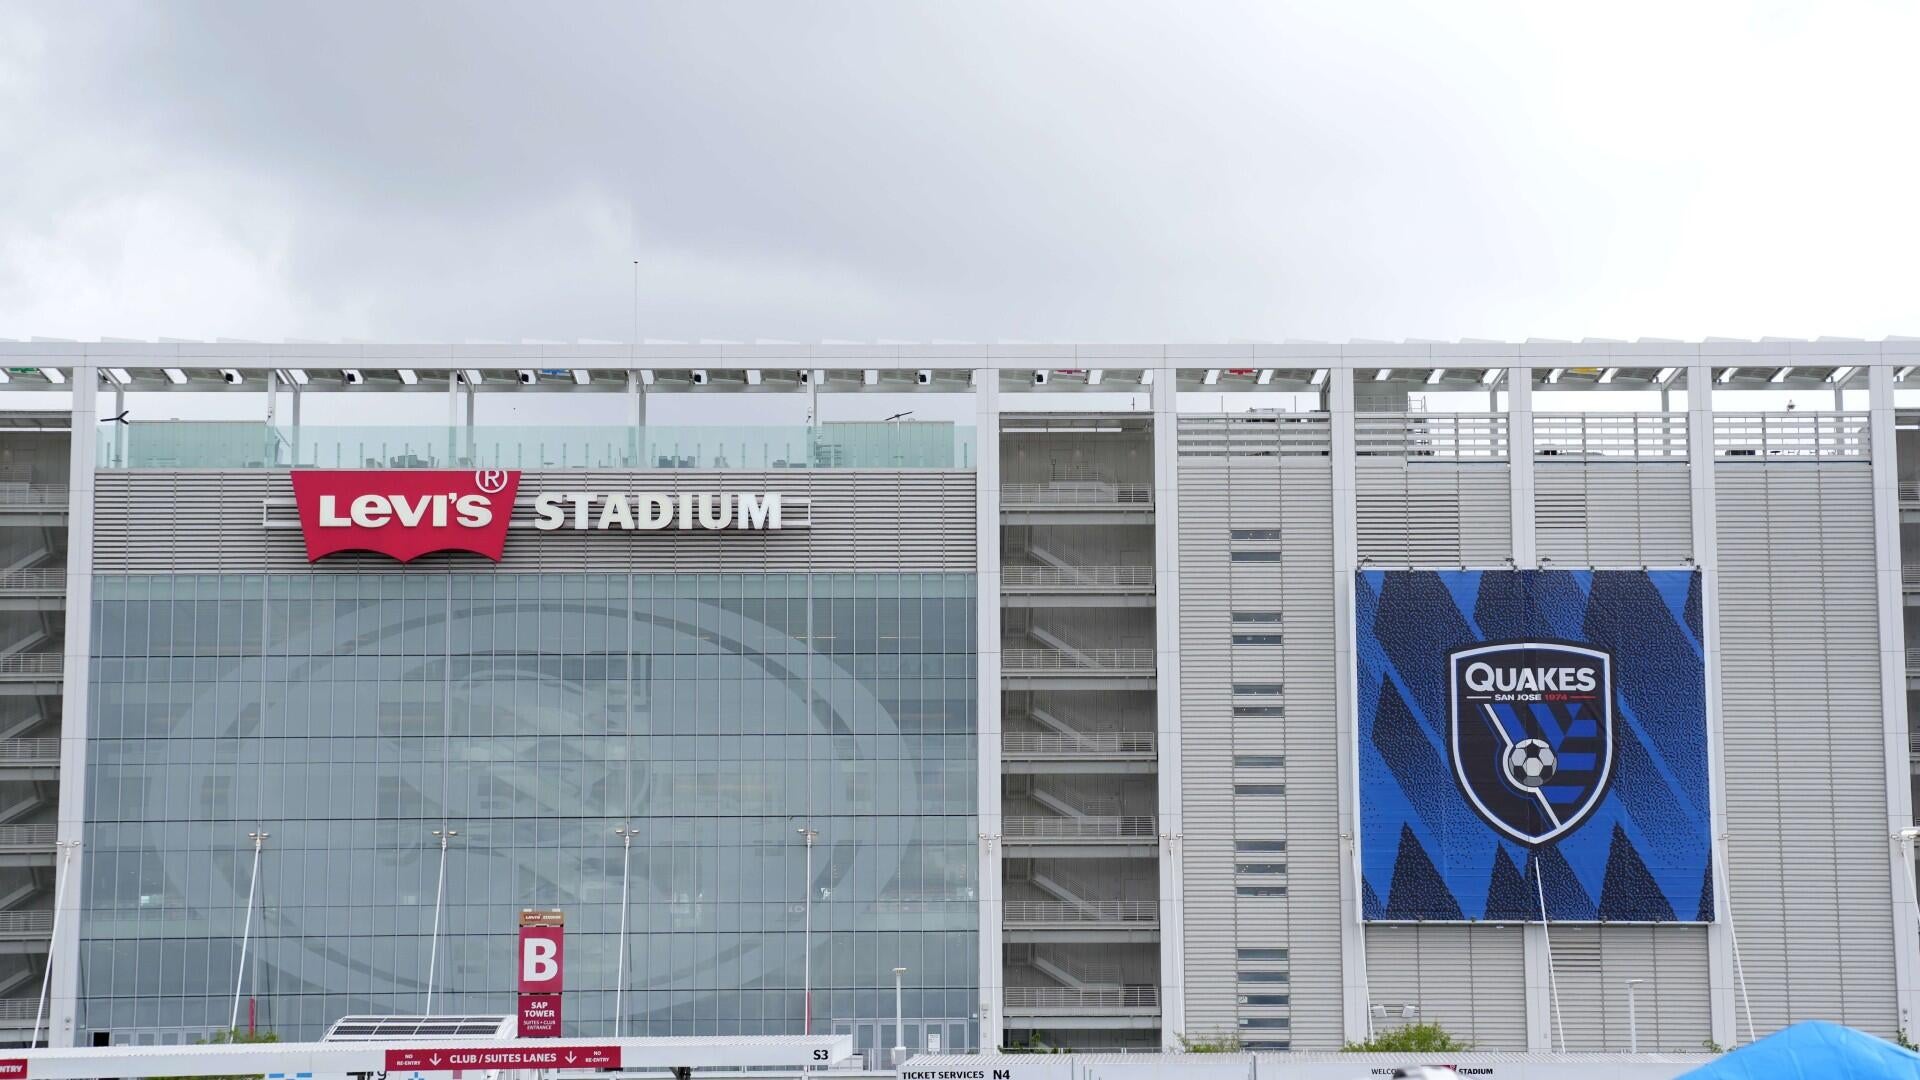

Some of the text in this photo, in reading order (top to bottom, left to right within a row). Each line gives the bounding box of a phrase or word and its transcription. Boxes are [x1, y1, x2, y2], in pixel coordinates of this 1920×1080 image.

[534, 492, 782, 530] STADIUM
[1465, 662, 1597, 692] QUAKES
[524, 938, 558, 981] B
[531, 1001, 548, 1009] SAP
[450, 1053, 557, 1064] CLUB / SUITES LANES
[813, 1049, 829, 1060] S3
[903, 1071, 984, 1080] TICKET SERVICES
[993, 1070, 1010, 1080] N4
